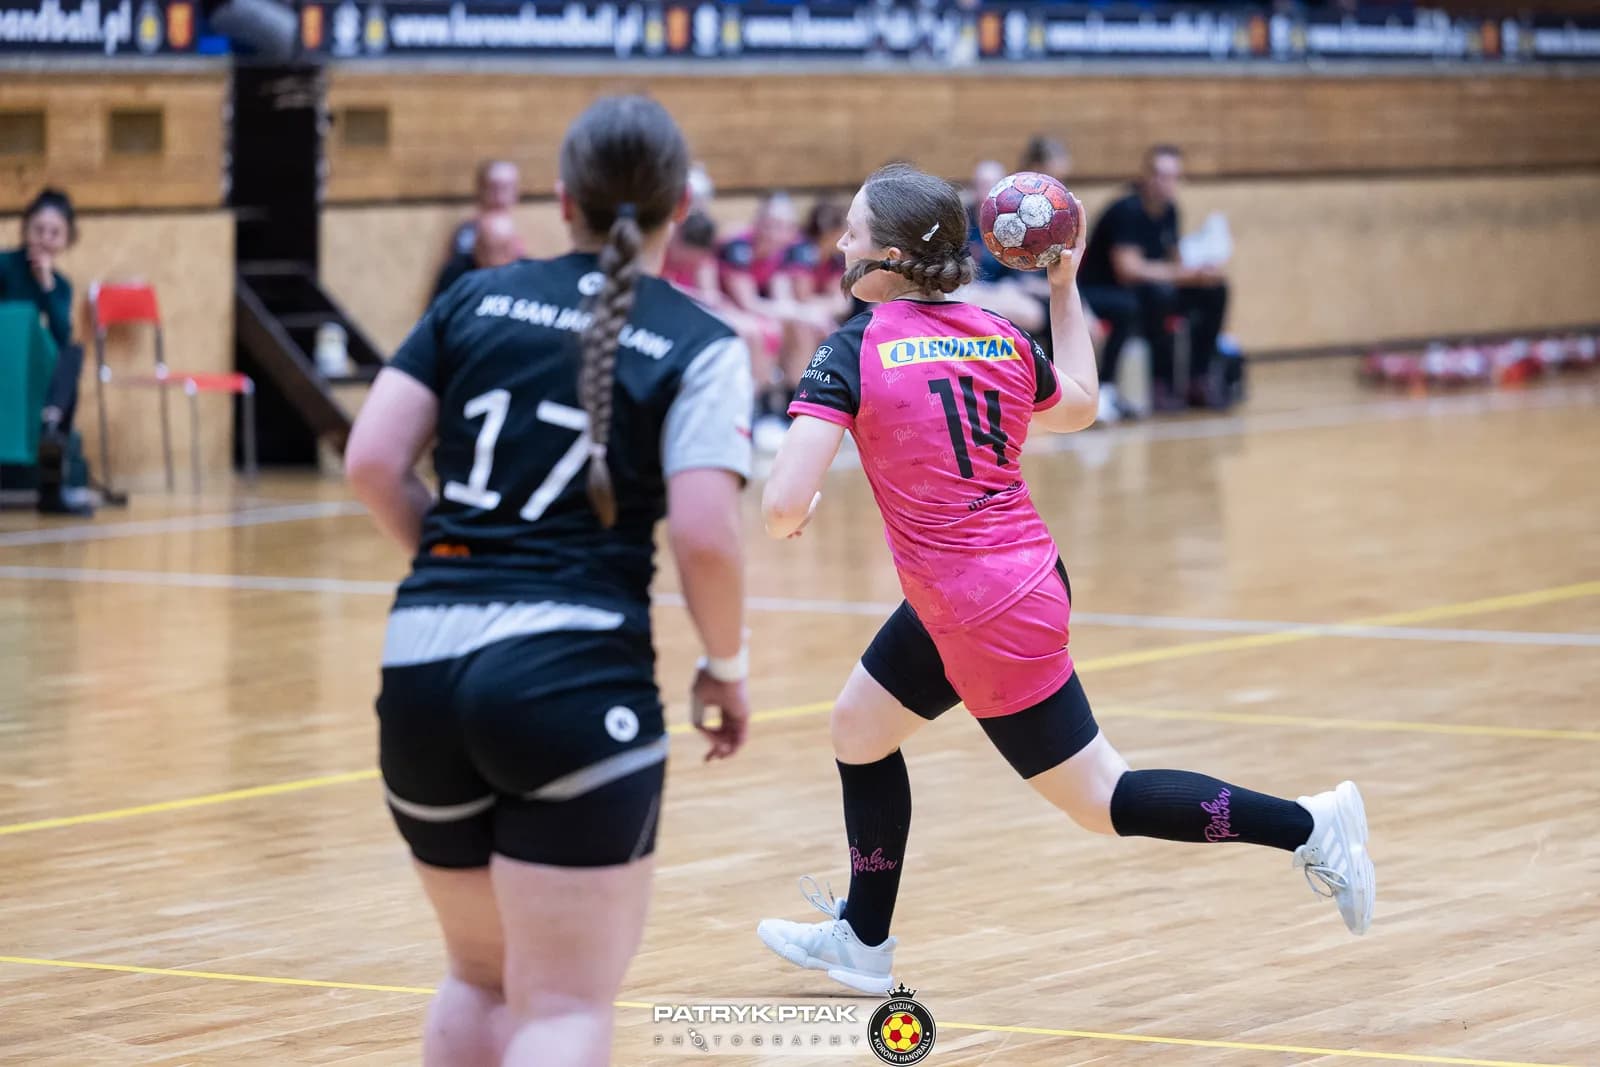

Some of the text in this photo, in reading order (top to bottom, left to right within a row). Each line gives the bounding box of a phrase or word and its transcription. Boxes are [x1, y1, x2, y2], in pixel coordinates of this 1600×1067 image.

[509, 298, 560, 328] SAN
[918, 338, 1013, 359] LEWIATAN
[802, 369, 831, 384] OFIKA
[928, 375, 1009, 479] 14
[443, 388, 594, 521] 17
